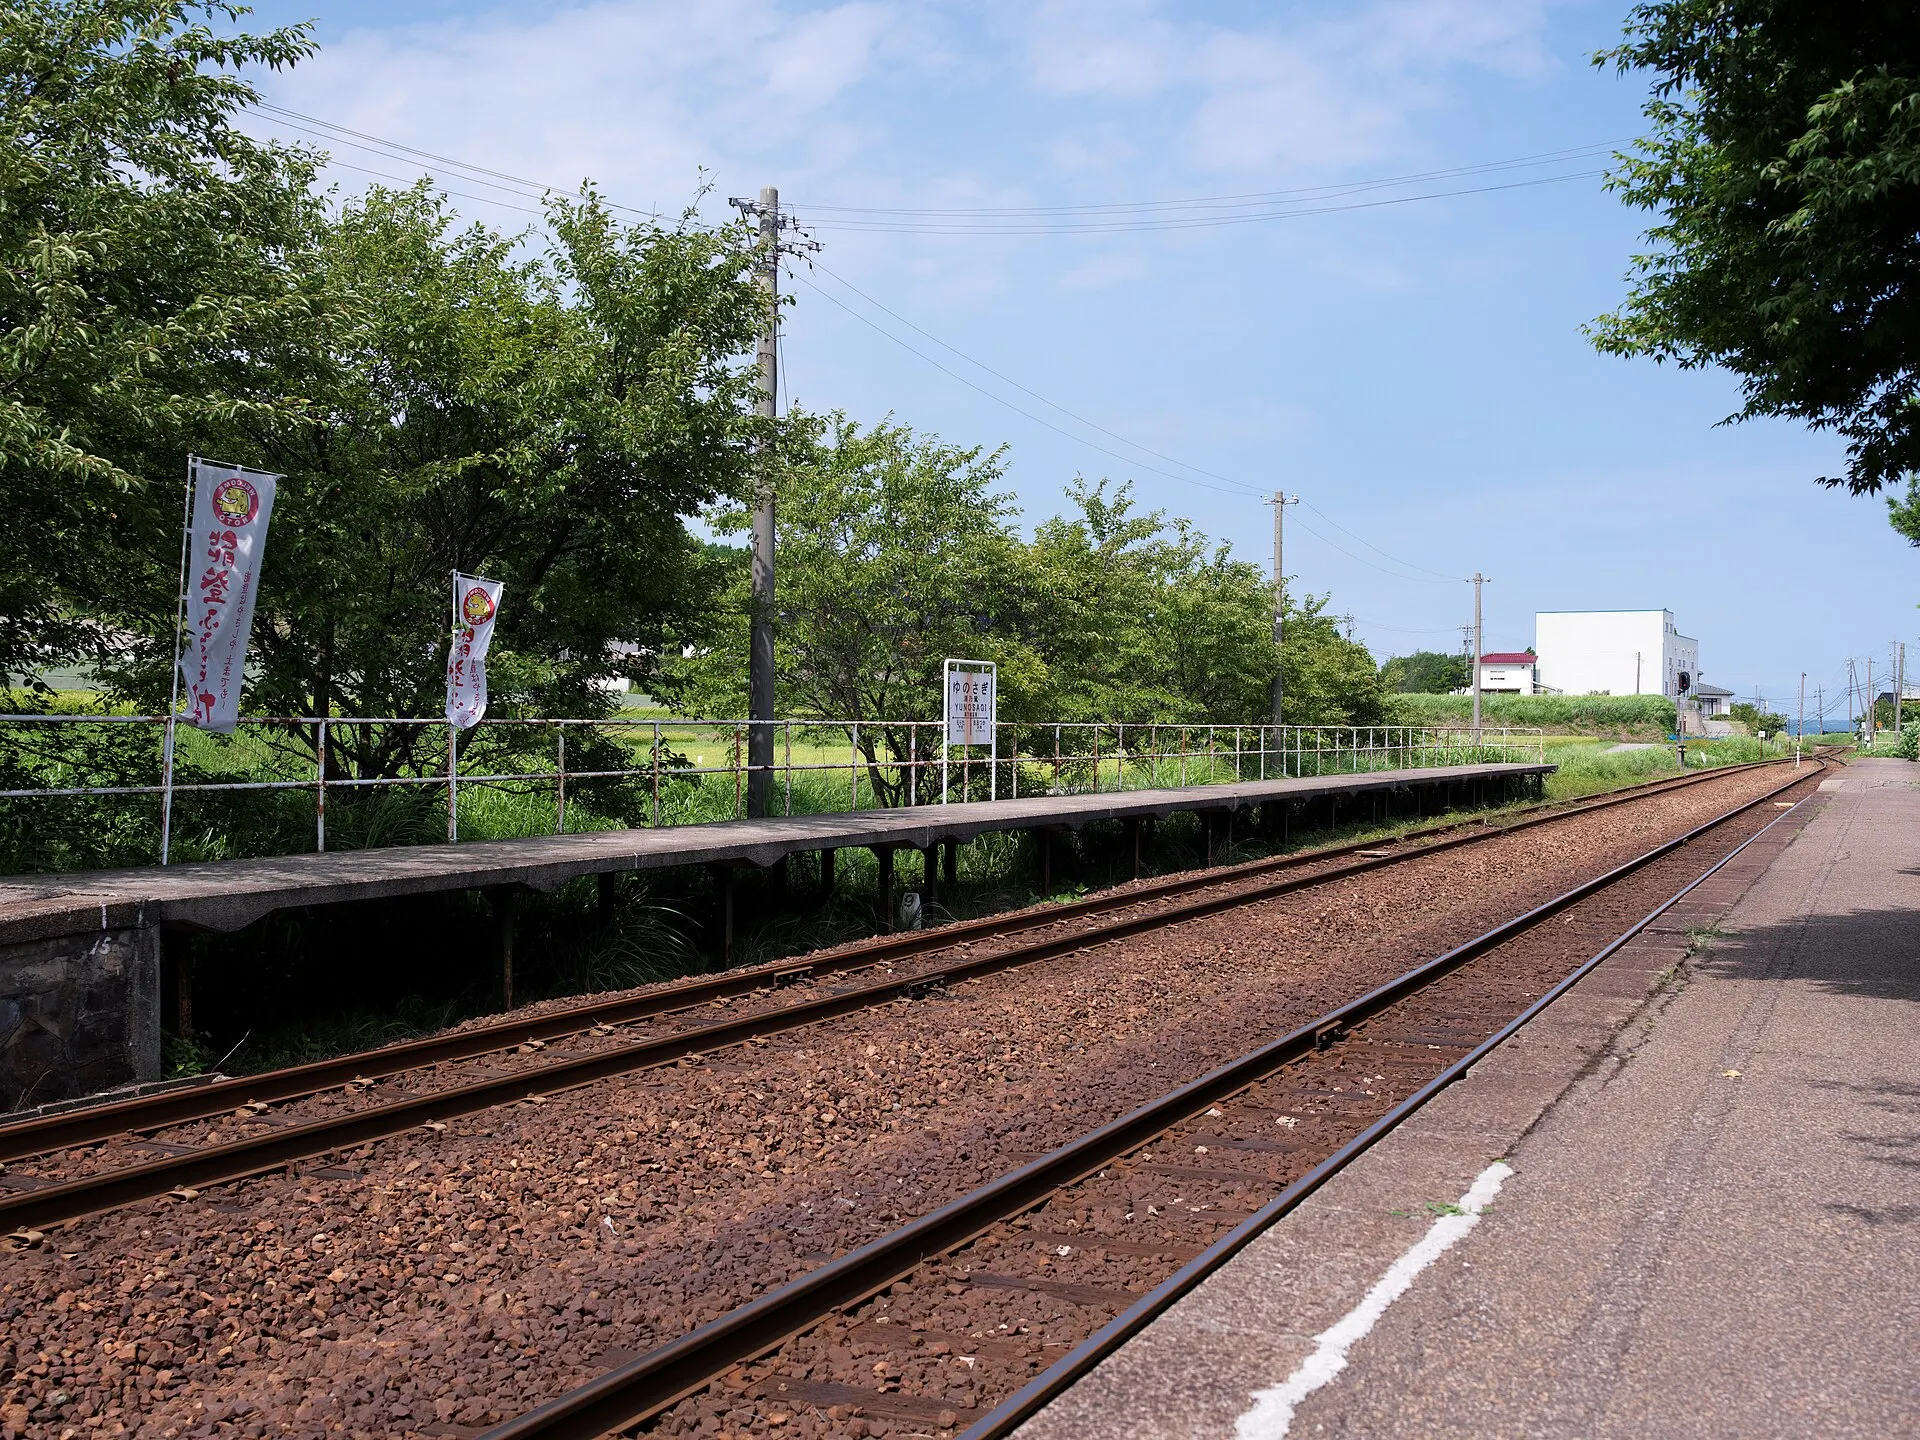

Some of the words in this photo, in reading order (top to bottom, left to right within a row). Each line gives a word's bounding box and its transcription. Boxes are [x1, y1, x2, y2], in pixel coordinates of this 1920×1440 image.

[953, 681, 988, 695] ゆのさぎ
[955, 703, 987, 712] YUNOSAGI
